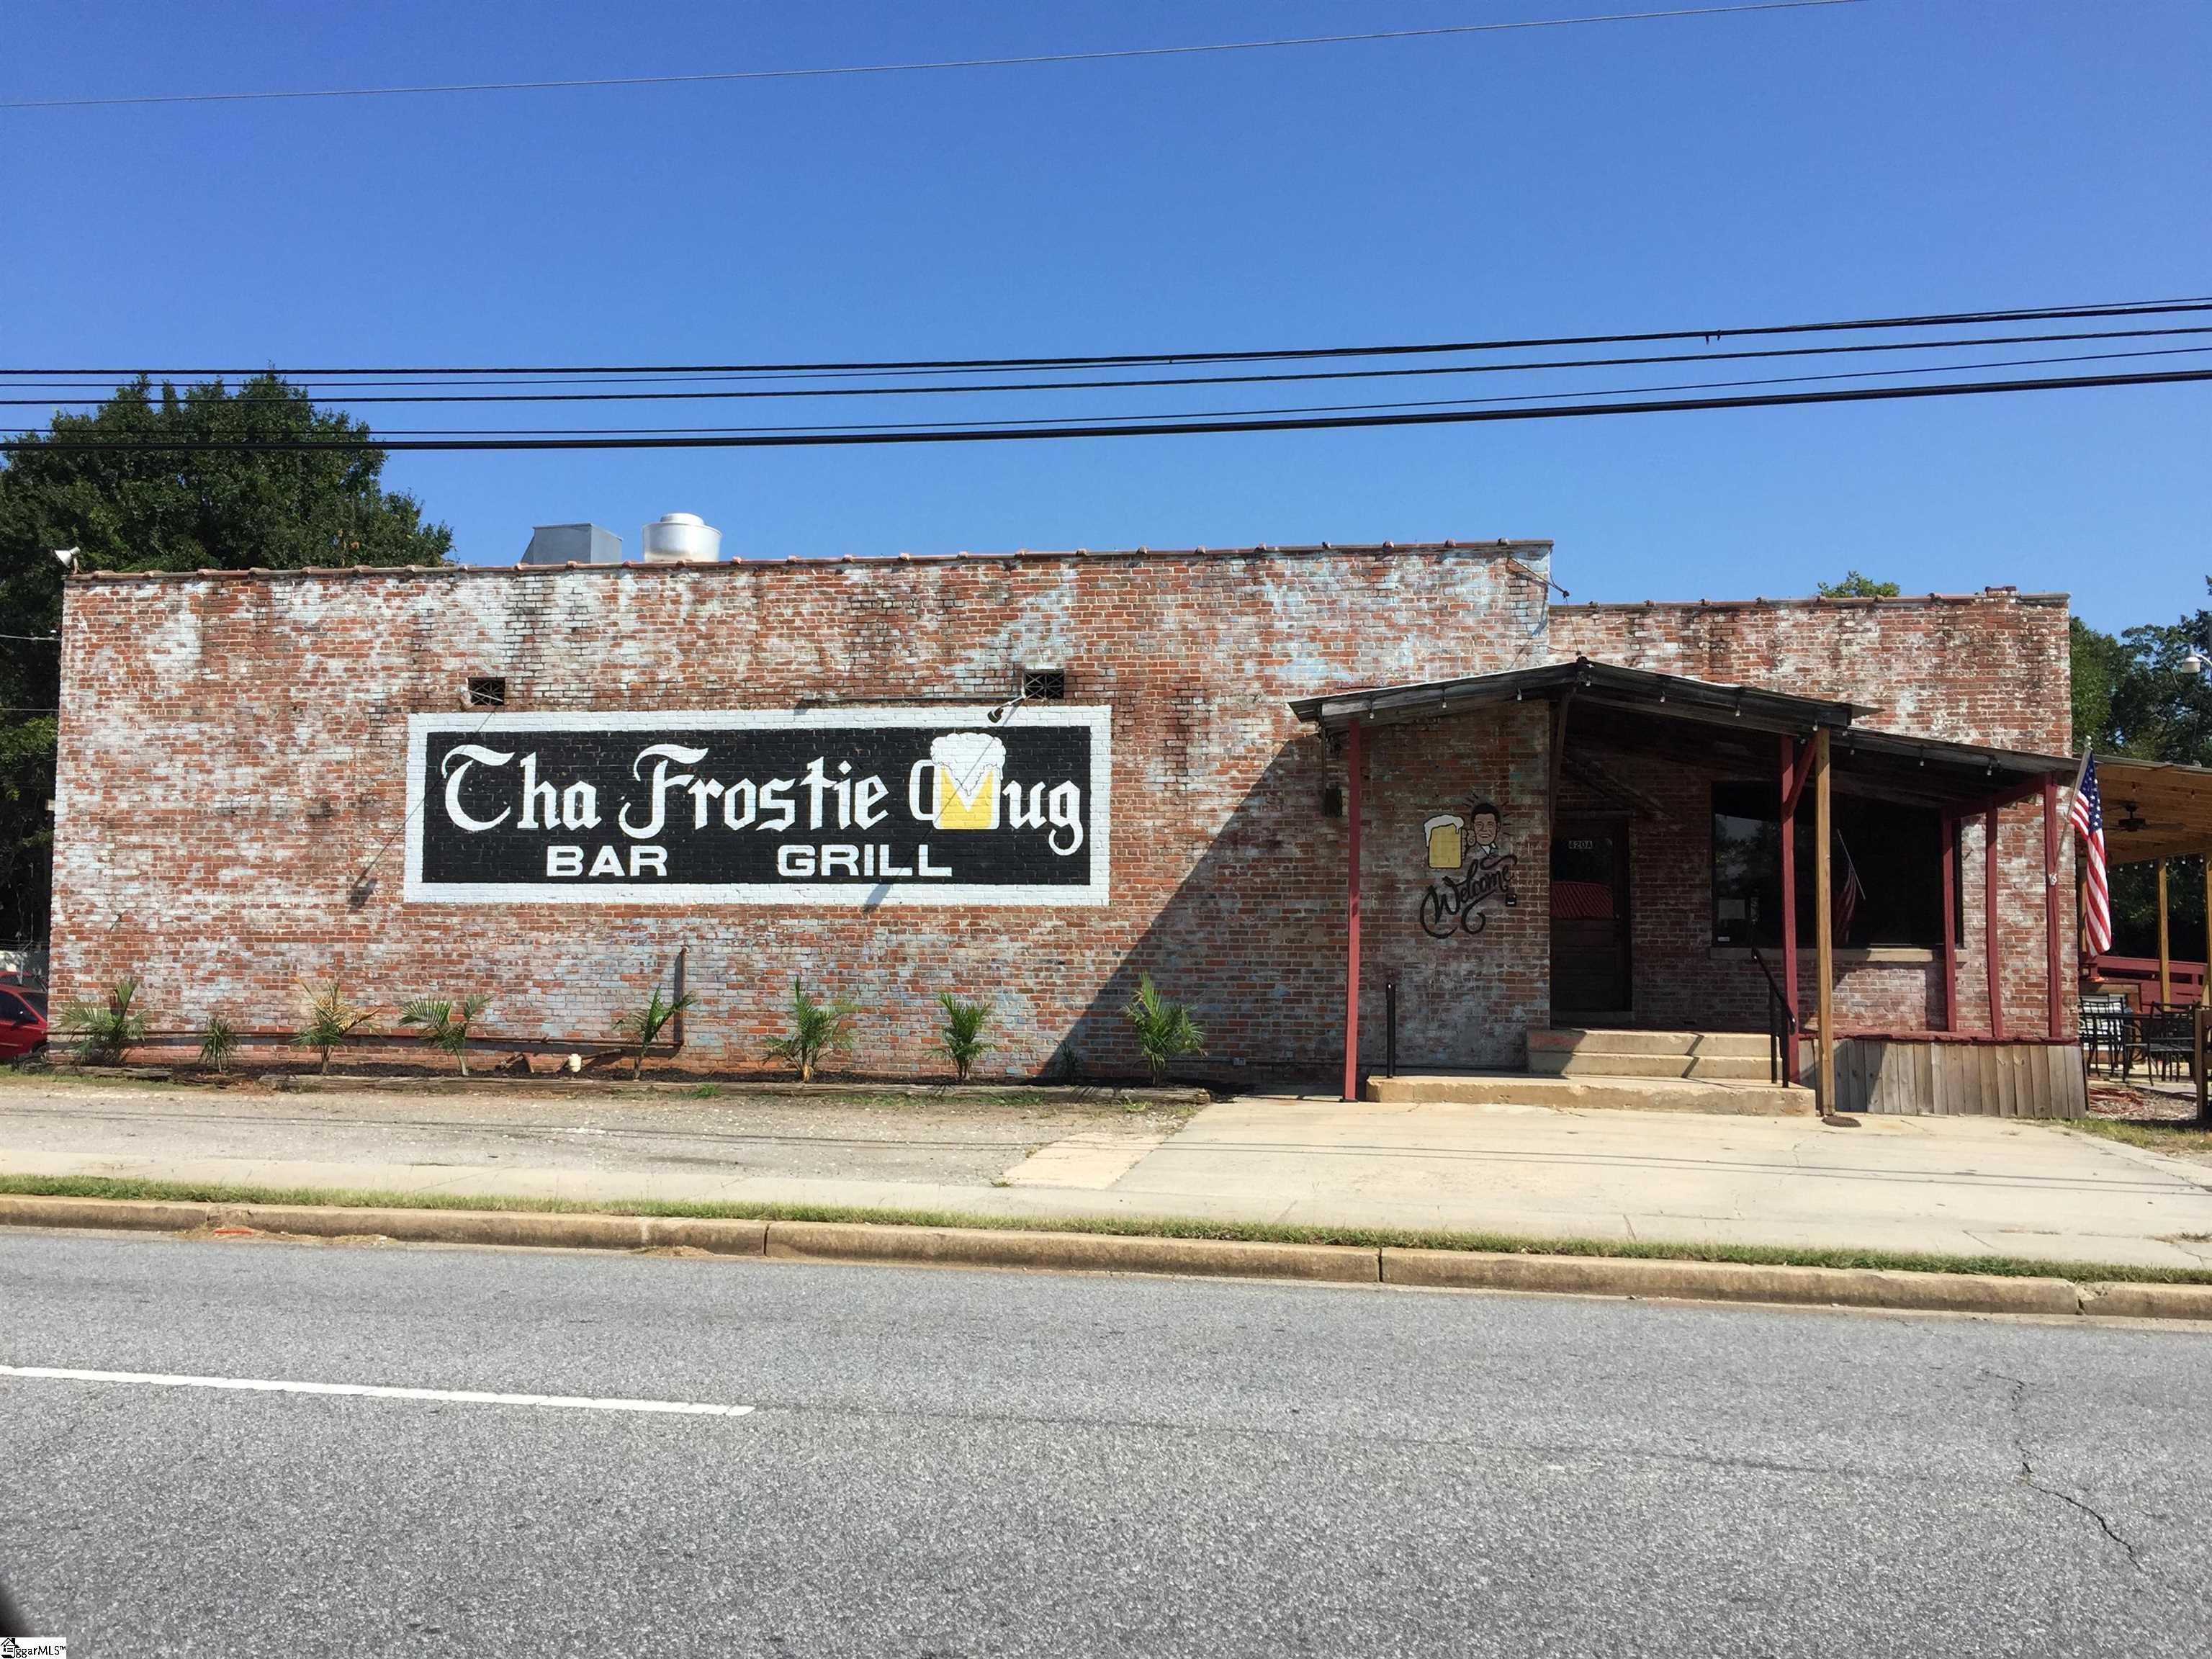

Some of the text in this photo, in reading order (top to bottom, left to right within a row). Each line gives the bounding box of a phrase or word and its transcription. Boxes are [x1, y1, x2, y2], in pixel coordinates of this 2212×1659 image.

[441, 732, 1084, 856] Tha Frostie Mug
[547, 844, 953, 877] BAR GRILL
[1419, 854, 1518, 939] Welcome
